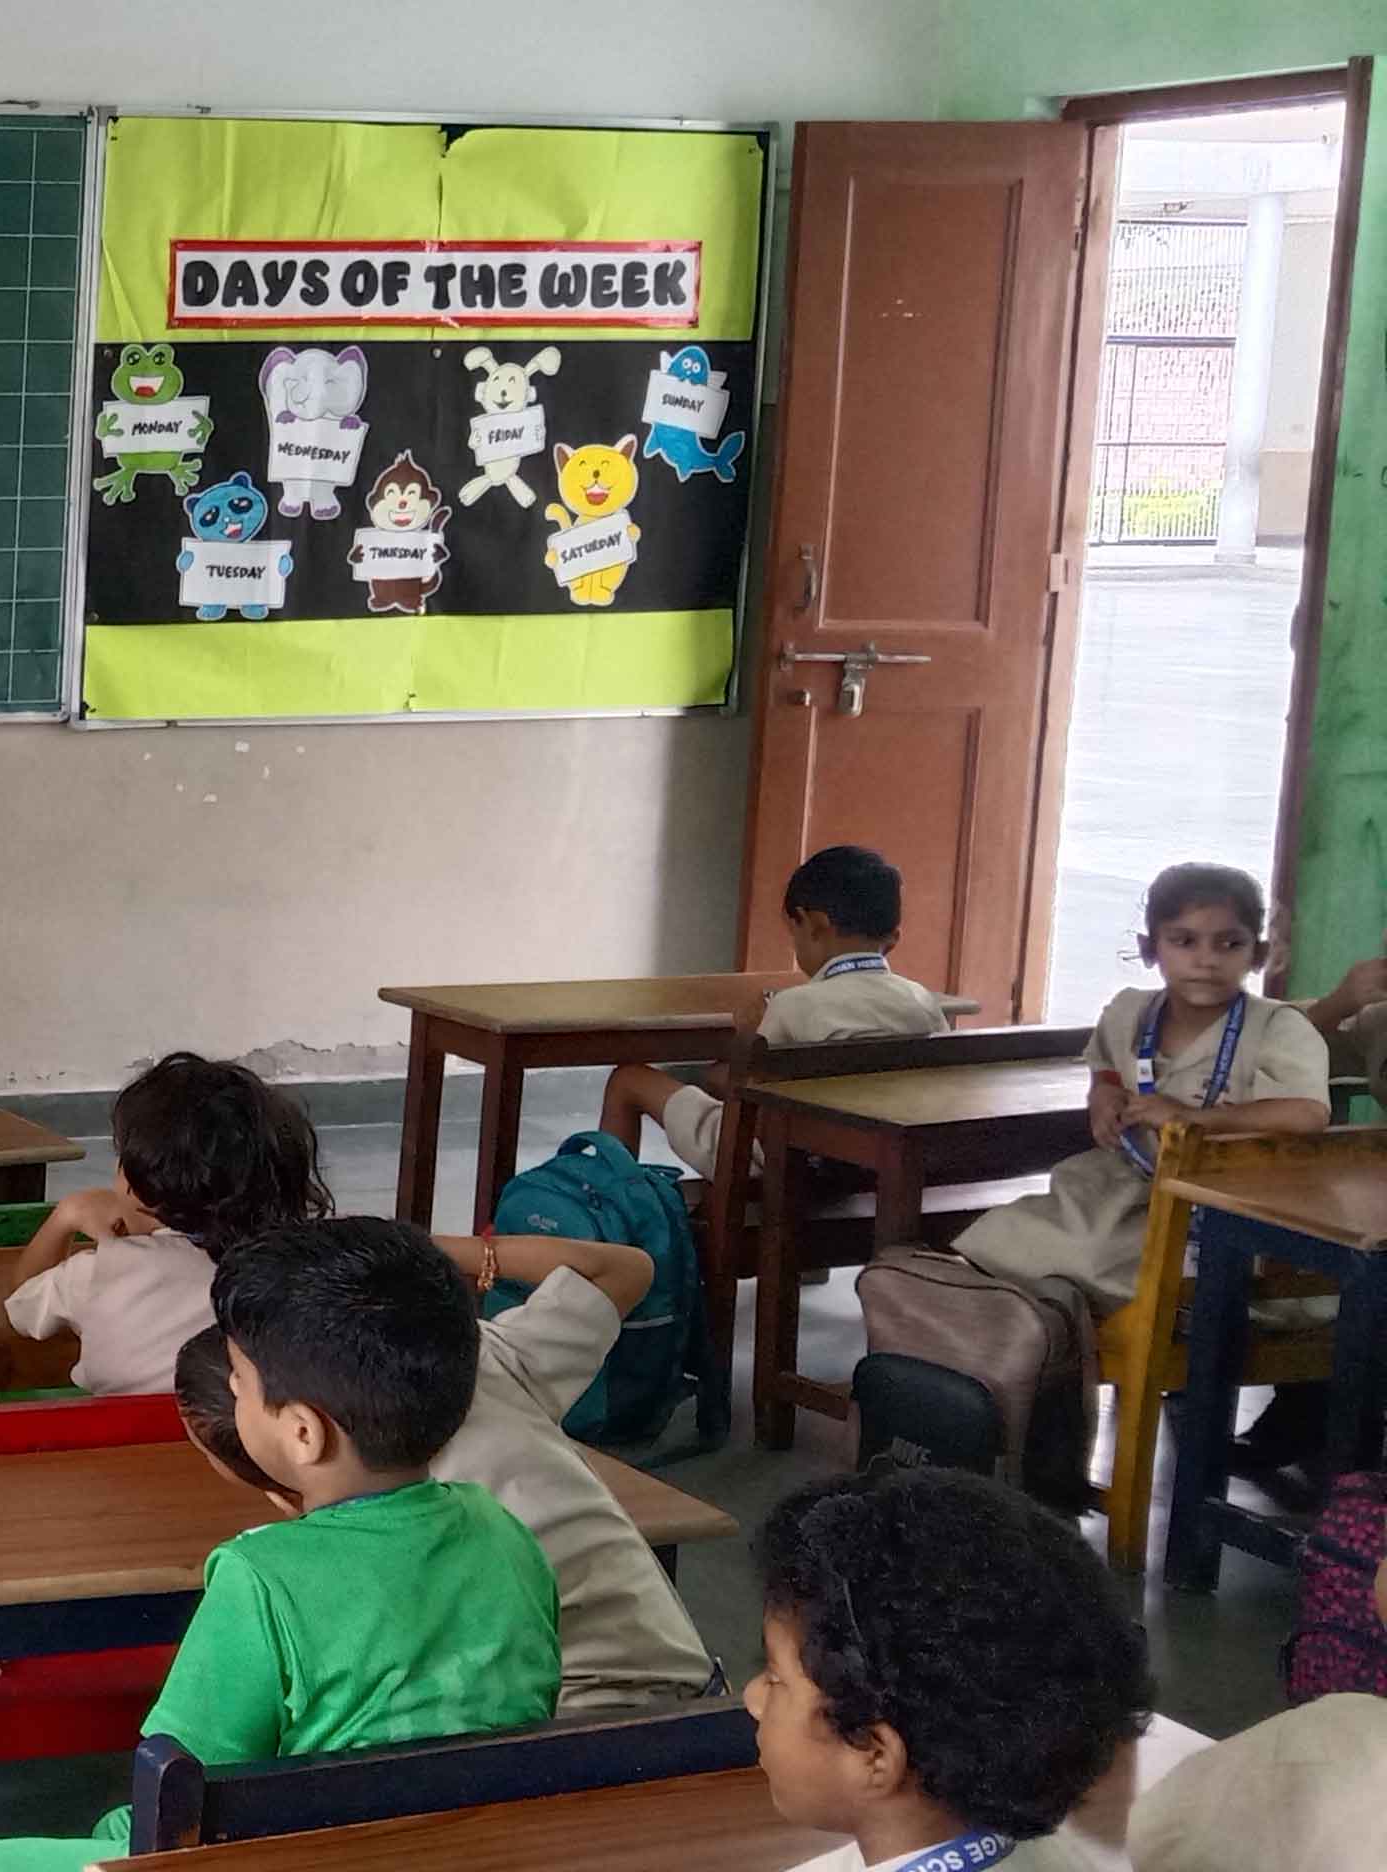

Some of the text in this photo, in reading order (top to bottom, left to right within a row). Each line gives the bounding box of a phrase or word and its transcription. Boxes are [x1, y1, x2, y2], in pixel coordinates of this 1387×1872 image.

[181, 259, 687, 310] DAYS OF THE WEEK
[661, 393, 705, 413] SUNDAY
[131, 420, 183, 436] MONDAY
[487, 426, 525, 444] FRIDAY
[277, 443, 351, 464] WEDNESDAY
[560, 531, 623, 564] SATURDAY
[206, 565, 266, 580] TUESDAY
